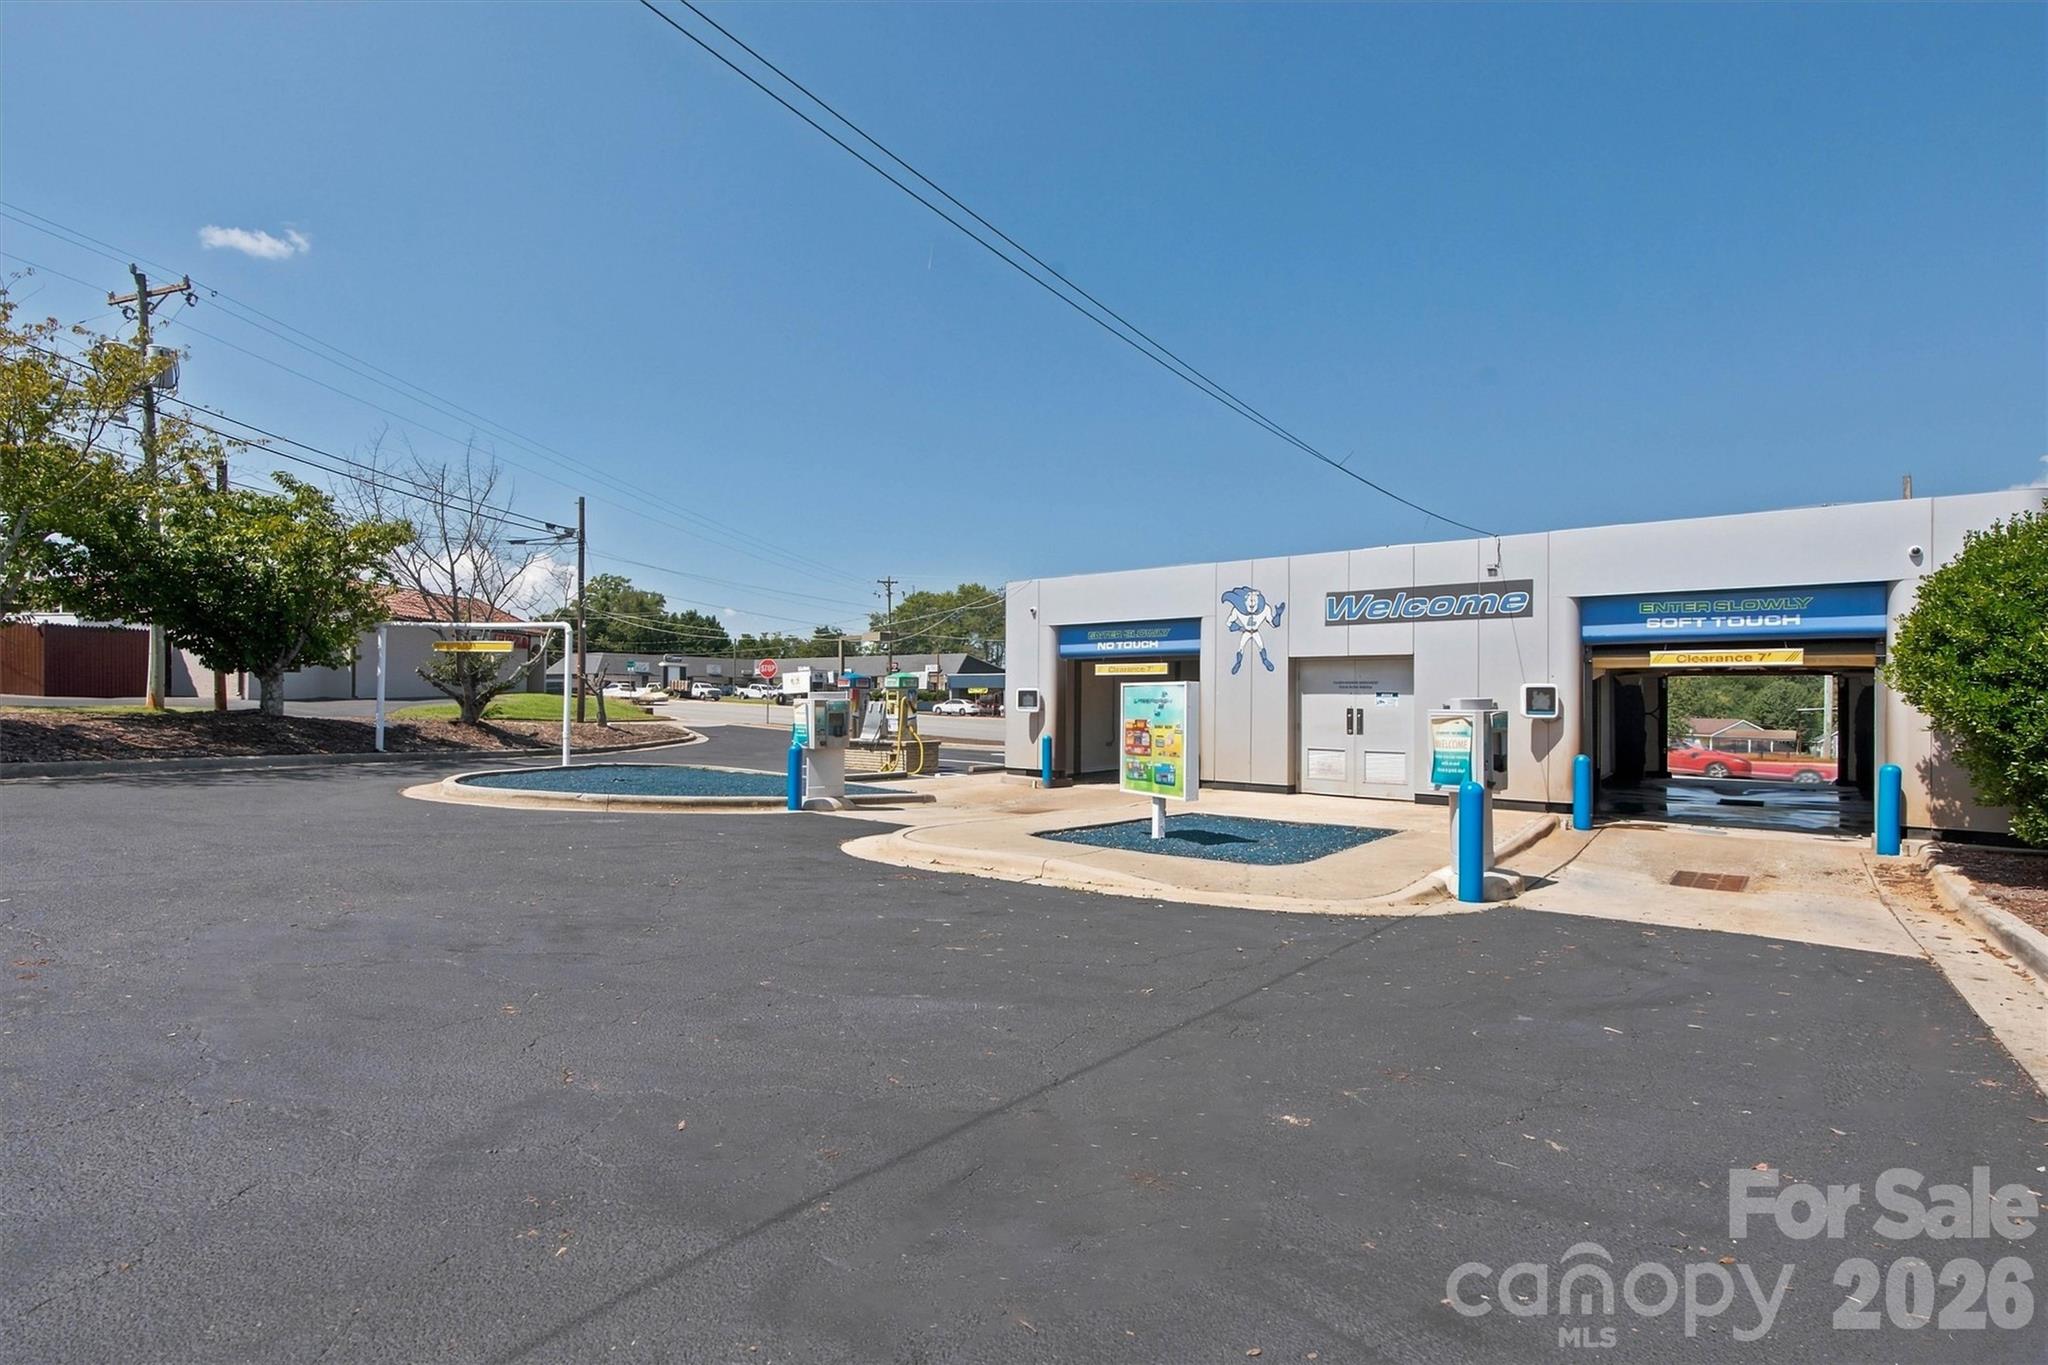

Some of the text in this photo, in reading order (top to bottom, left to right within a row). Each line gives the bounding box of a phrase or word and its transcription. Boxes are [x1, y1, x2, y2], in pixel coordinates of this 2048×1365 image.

[1326, 591, 1530, 622] Welcome
[1639, 596, 1814, 614] ENTER SLOWLY
[1646, 614, 1801, 629] SOFT TOUCH
[1097, 640, 1159, 651] NO TOUCH
[1676, 653, 1753, 664] Clearance
[760, 664, 776, 673] STOP
